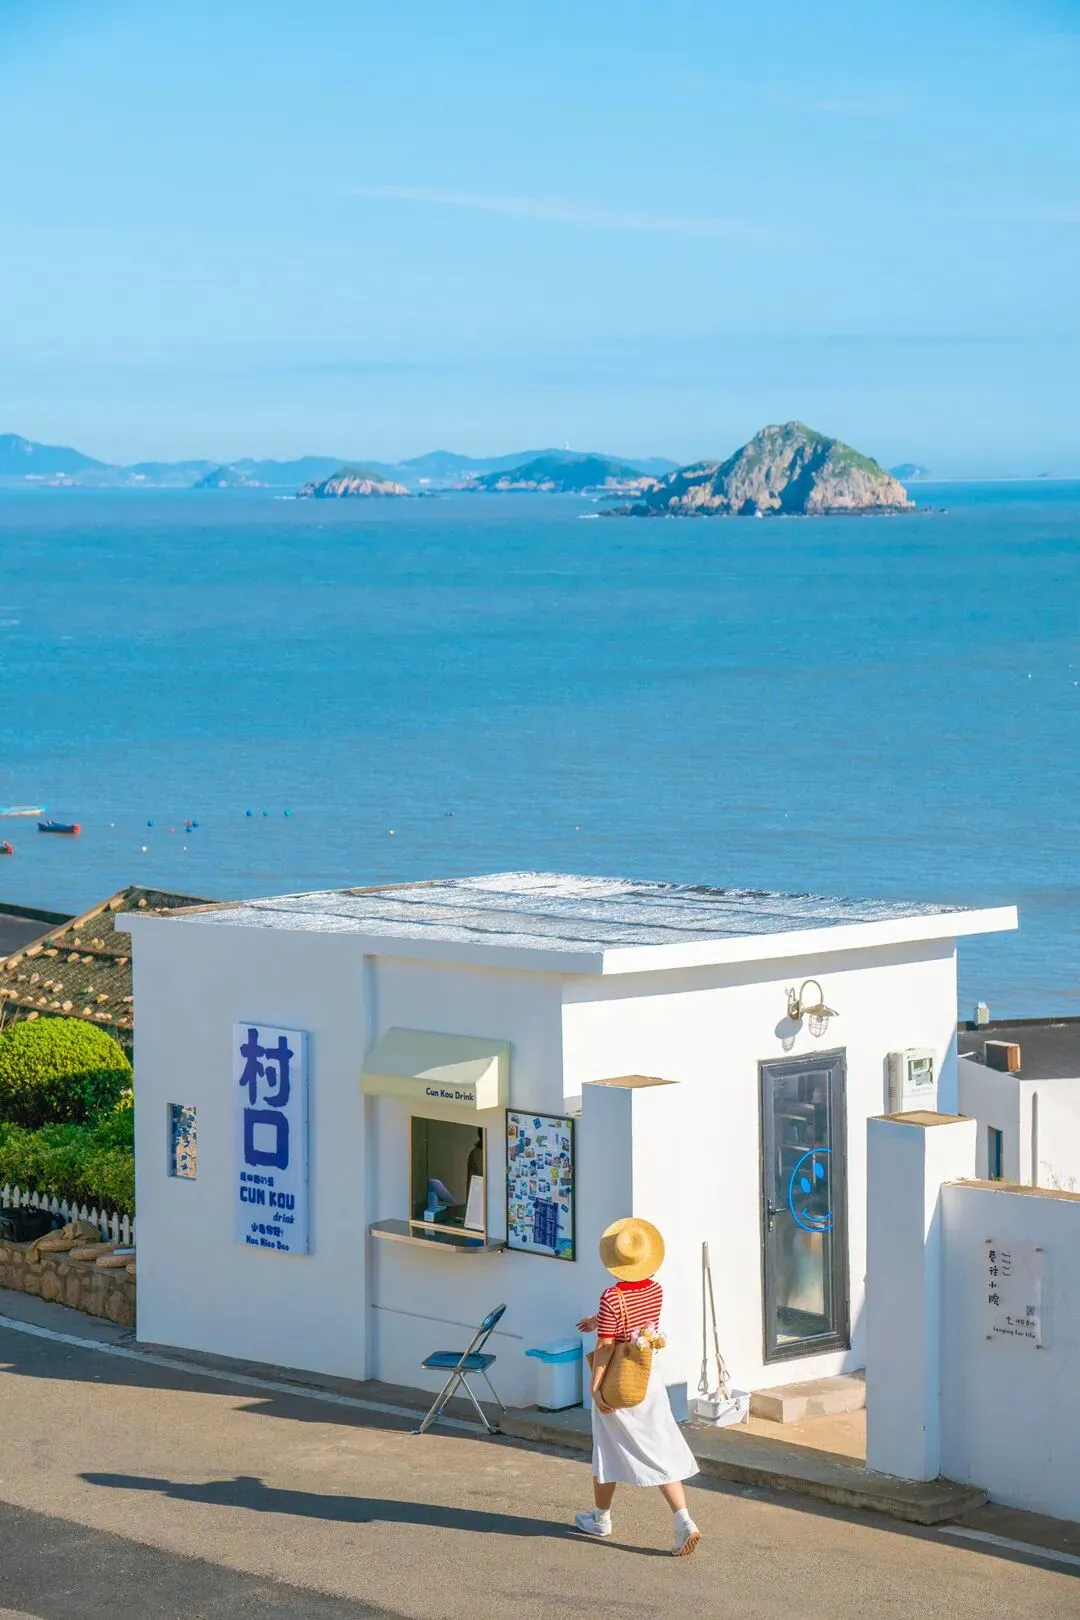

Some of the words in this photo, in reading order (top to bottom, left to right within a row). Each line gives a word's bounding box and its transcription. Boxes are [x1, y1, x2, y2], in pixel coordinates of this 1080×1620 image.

[239, 1027, 295, 1171] 村口
[425, 1087, 439, 1097] Cun
[440, 1090, 453, 1099] Kou
[455, 1091, 474, 1101] Drink
[240, 1185, 265, 1207] CUN
[268, 1190, 295, 1211] KOU
[272, 1211, 296, 1225] drink
